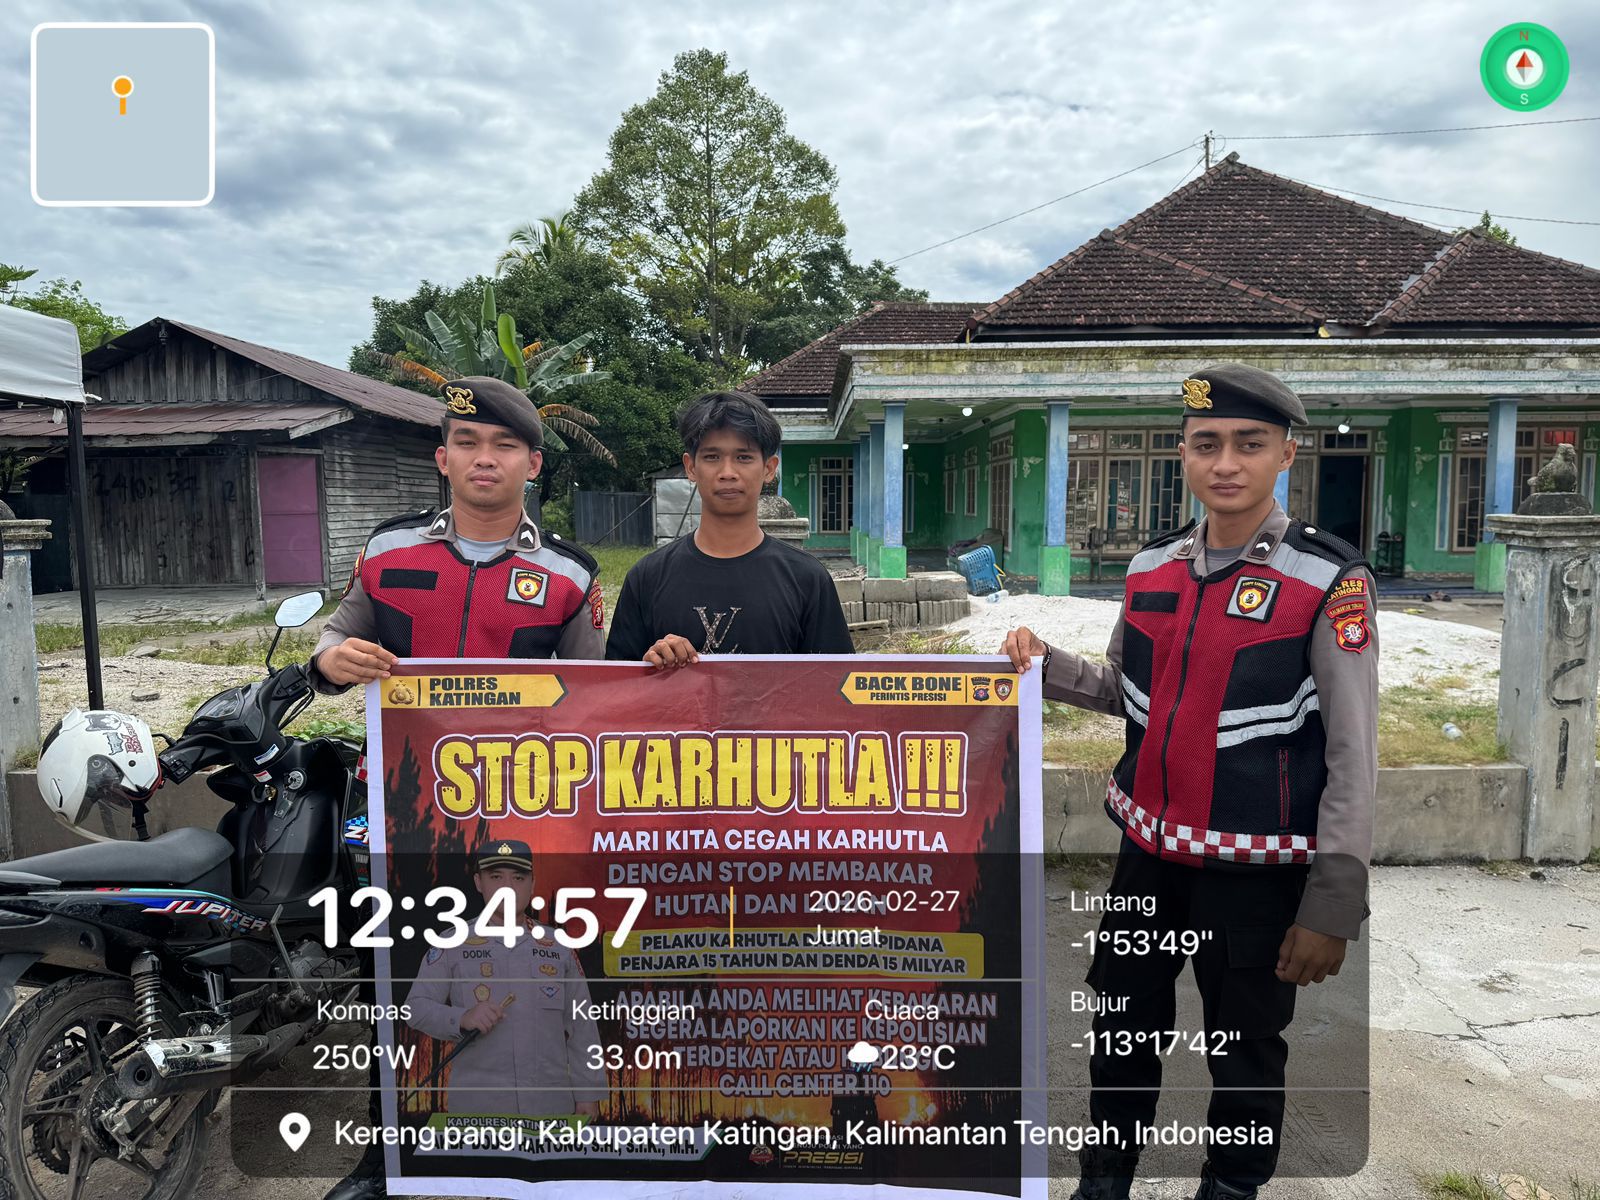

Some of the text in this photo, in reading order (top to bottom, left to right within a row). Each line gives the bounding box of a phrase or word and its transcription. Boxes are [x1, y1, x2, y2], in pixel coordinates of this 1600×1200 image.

[429, 676, 499, 691] POLRES
[855, 675, 907, 691] BACK
[911, 675, 962, 692] BONE
[429, 691, 521, 706] KATINGAN
[870, 691, 947, 702] PERINTIS PRESISI
[436, 736, 961, 815] STOP KARHUTLA !!!
[593, 828, 949, 853] MARI KITA CEGAH KARHUTLA
[608, 861, 933, 885] DENGAN STOP MEMBAKAR
[654, 893, 738, 916] HUTAN
[744, 893, 797, 914] DAN
[141, 899, 268, 932] JUPITER
[642, 933, 707, 950] PELAKU
[709, 932, 799, 949] KARHUTLA
[463, 949, 492, 960] DODIK
[532, 948, 560, 960] POLRI
[620, 953, 966, 973] PENJARA 15 TAHUN DAN DENDA 15 MILYAR
[616, 989, 705, 1011] APABILA
[708, 988, 768, 1011] ANDA
[772, 988, 864, 1012] MELIHAT
[626, 1017, 987, 1045] SEGERA LAPORKAN KE KEPOLISIAN
[780, 1046, 836, 1069] ATAU
[719, 1073, 892, 1096] CALL CENTER 110
[447, 1117, 507, 1128] KAPOLRES
[783, 1151, 865, 1165] PRESISI
